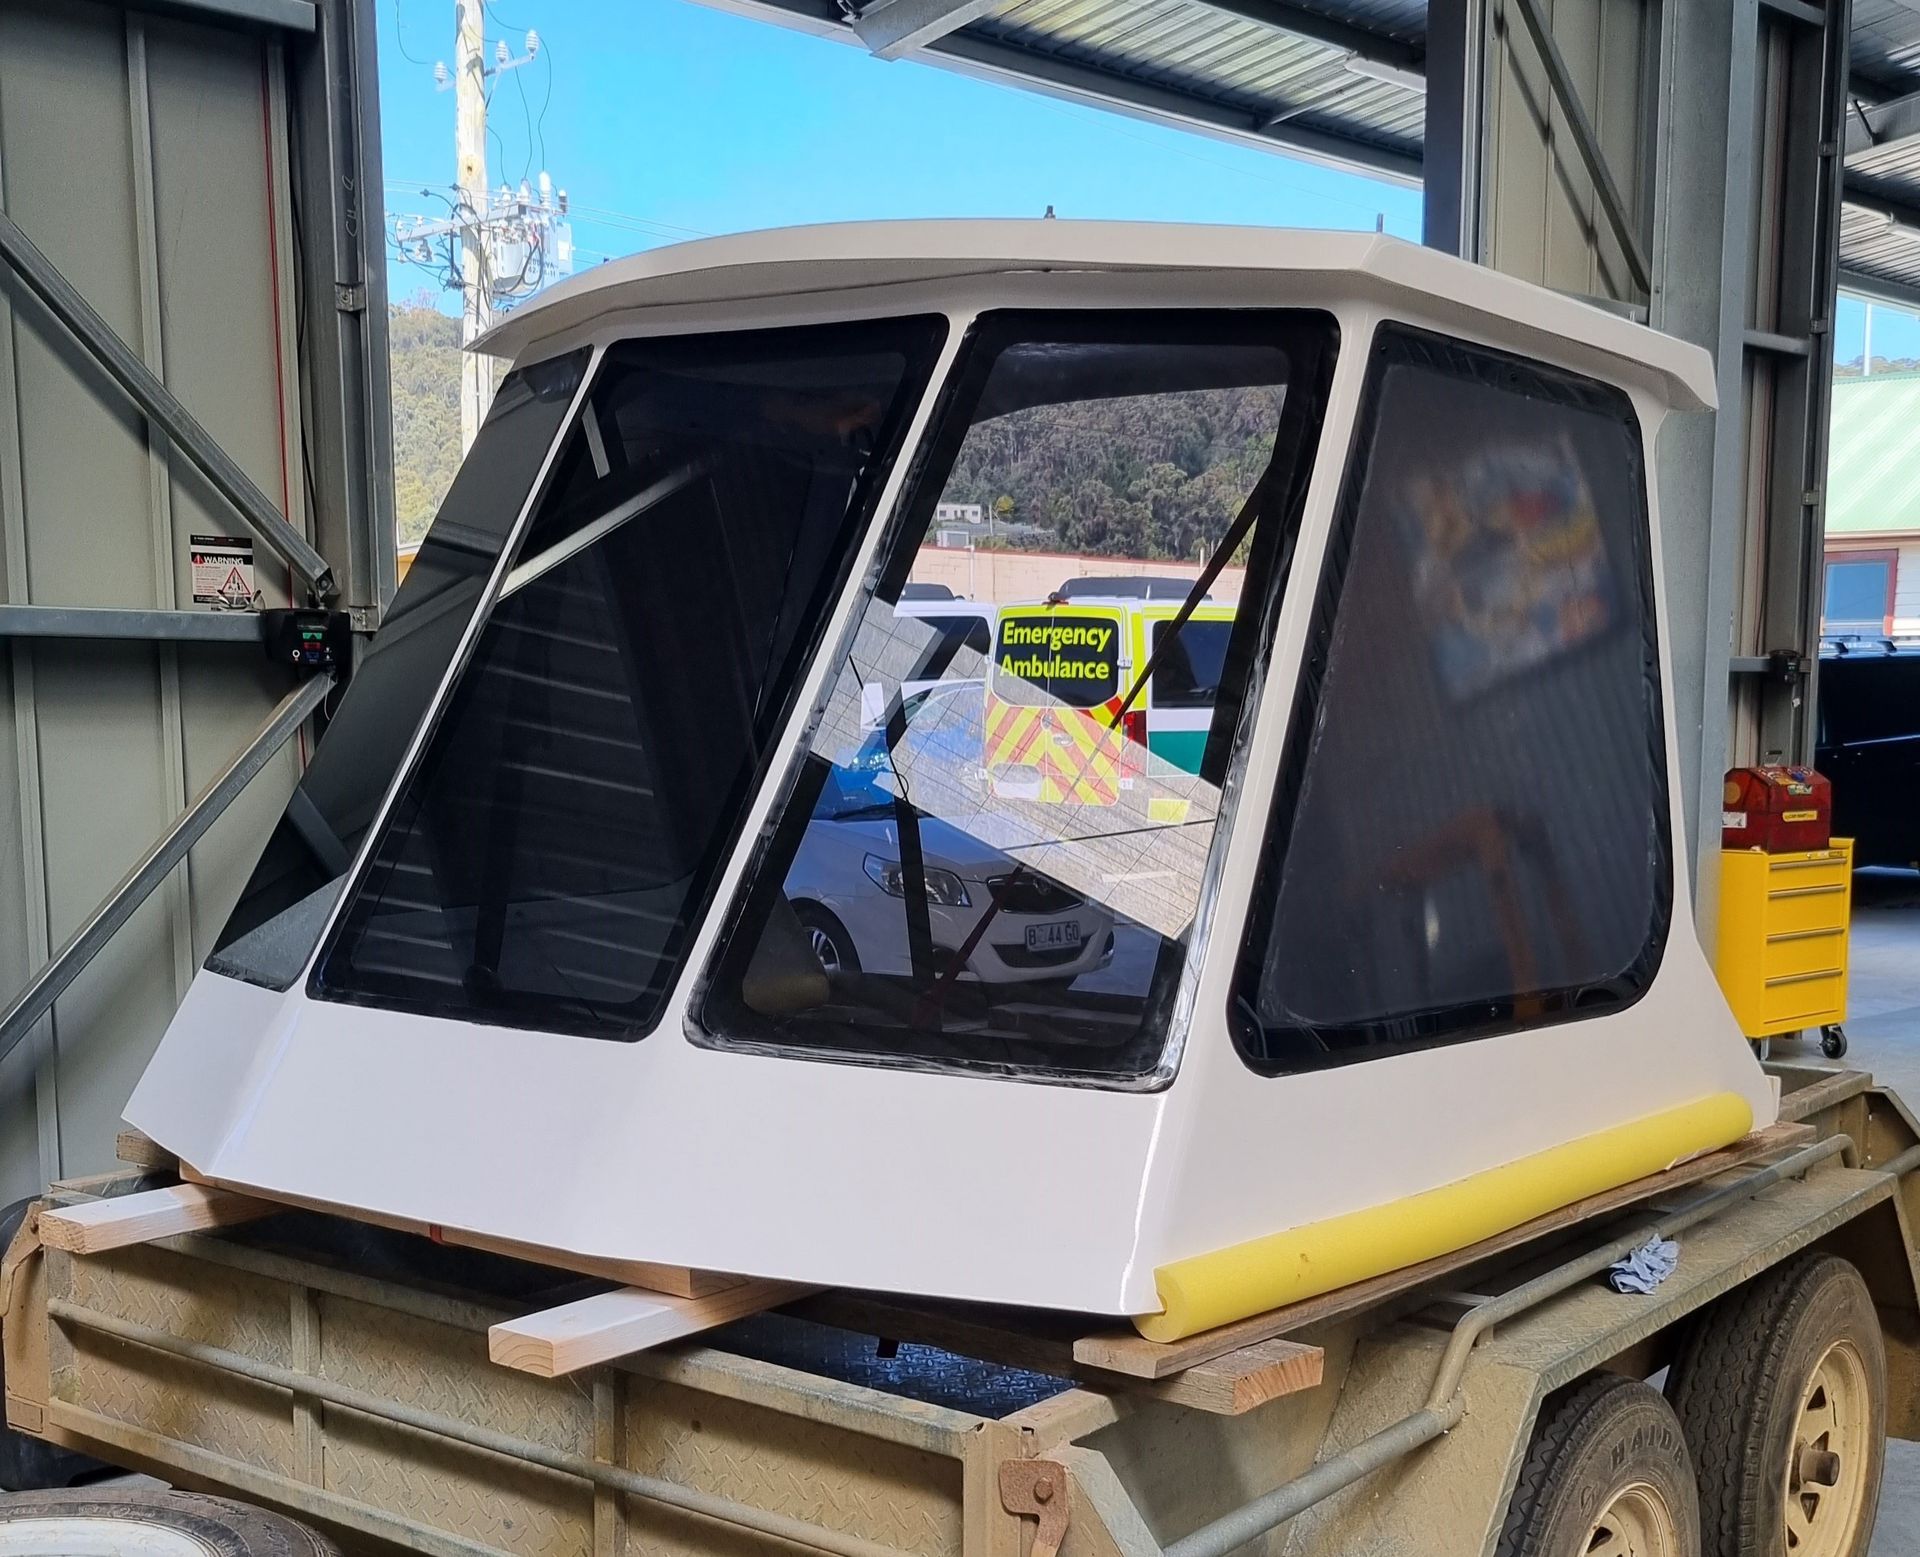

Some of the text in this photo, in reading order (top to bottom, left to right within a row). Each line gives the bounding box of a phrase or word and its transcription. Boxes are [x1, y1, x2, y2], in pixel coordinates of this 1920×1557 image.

[204, 555, 244, 566] WARNING
[1002, 621, 1111, 652] Emergency
[1000, 655, 1109, 679] Ambulance
